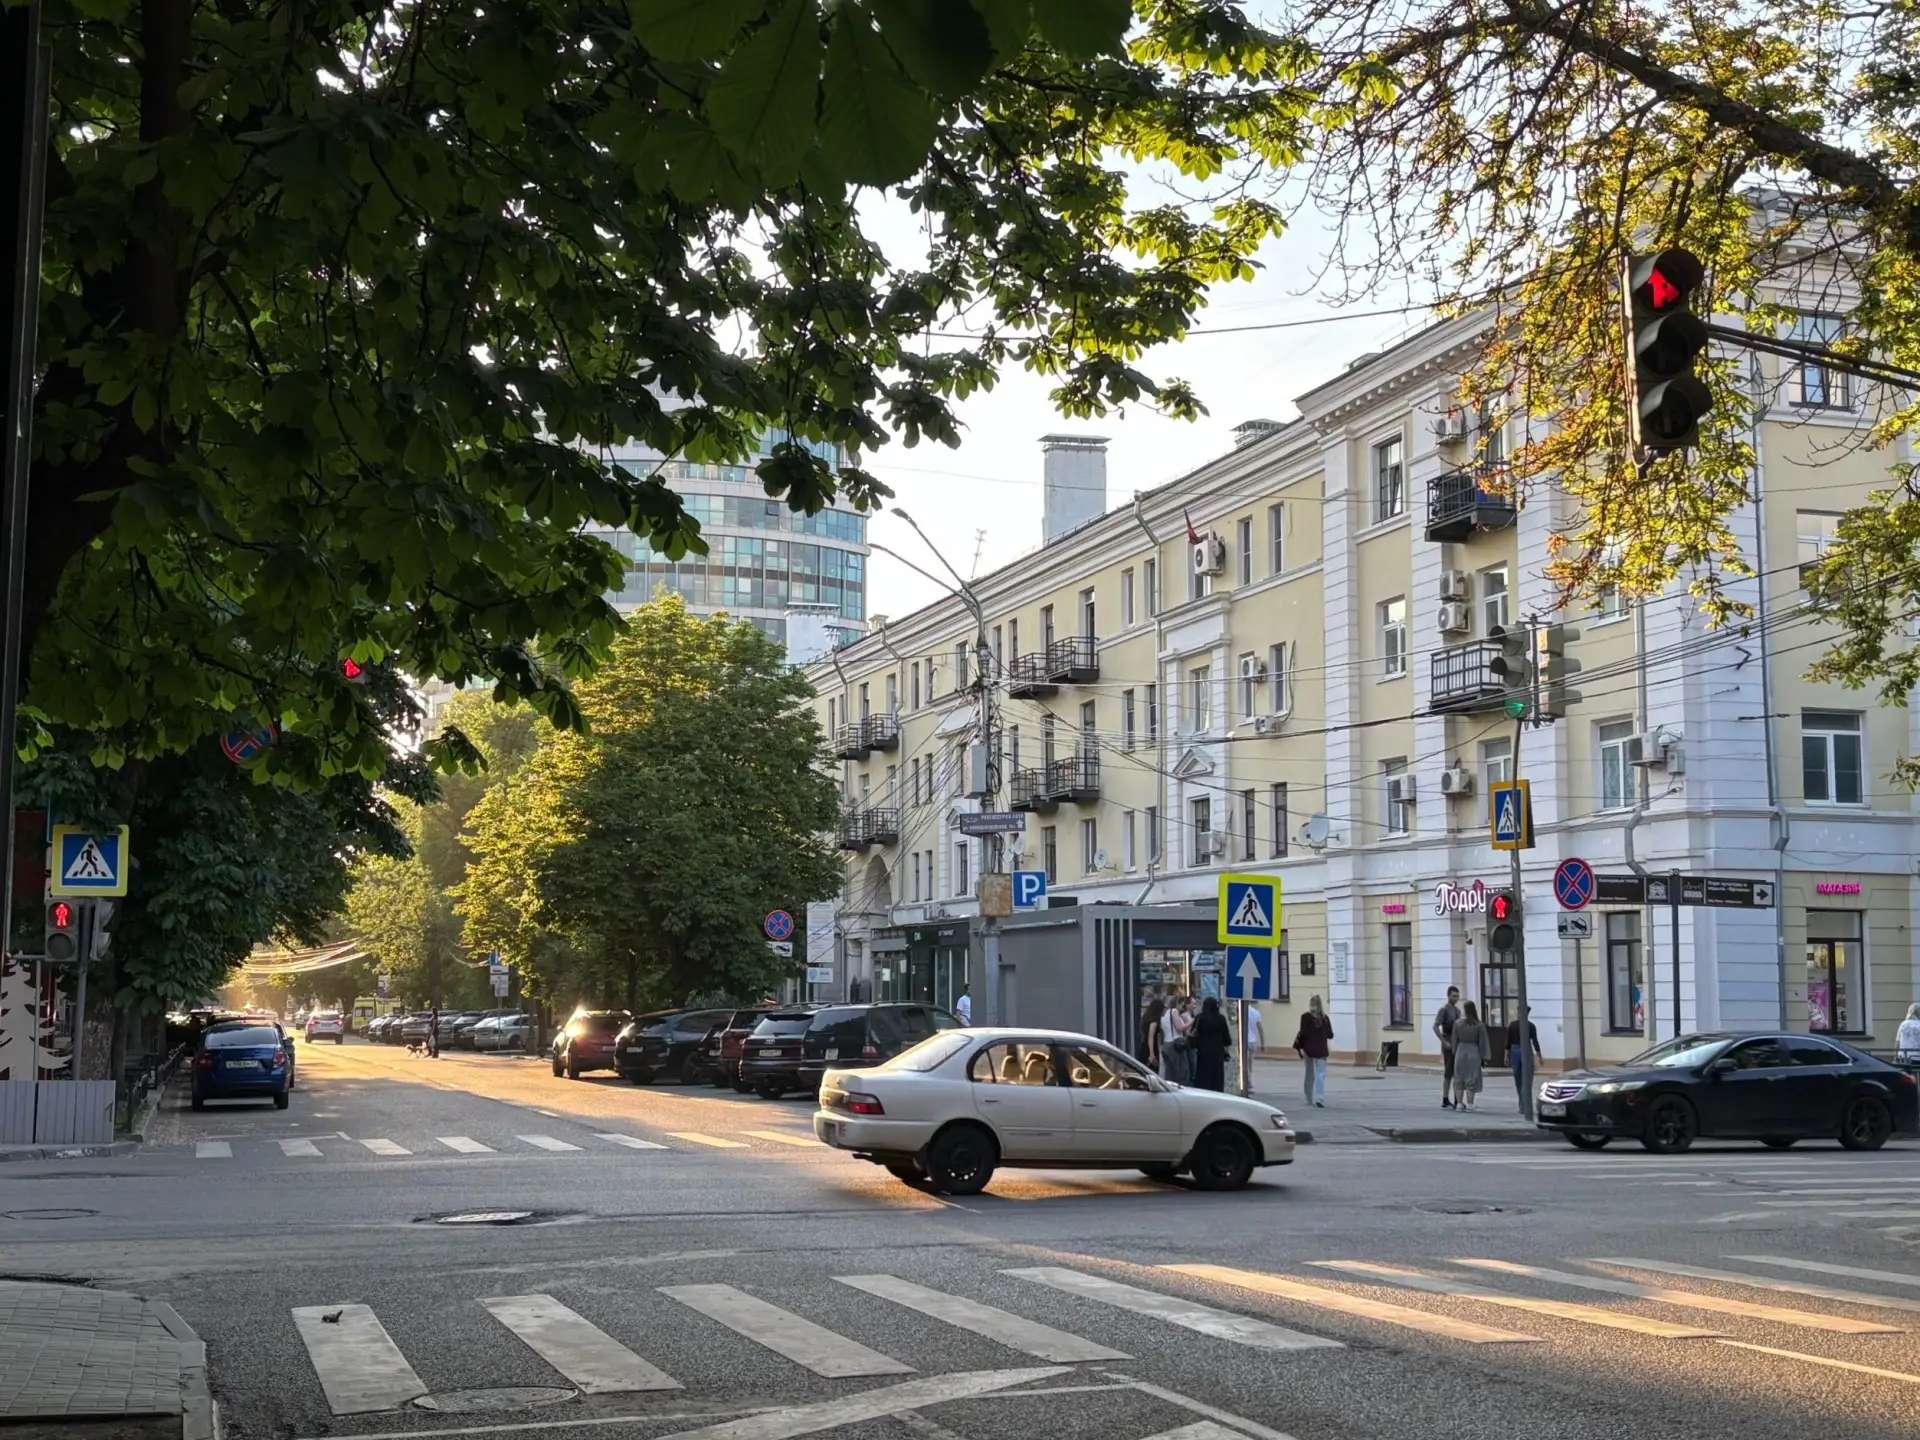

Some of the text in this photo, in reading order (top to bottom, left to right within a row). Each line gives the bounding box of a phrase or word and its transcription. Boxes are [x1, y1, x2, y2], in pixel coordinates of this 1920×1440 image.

[1021, 874, 1040, 903] P
[1436, 881, 1513, 915] Подру
[1817, 882, 1862, 894] МАГАЗИН
